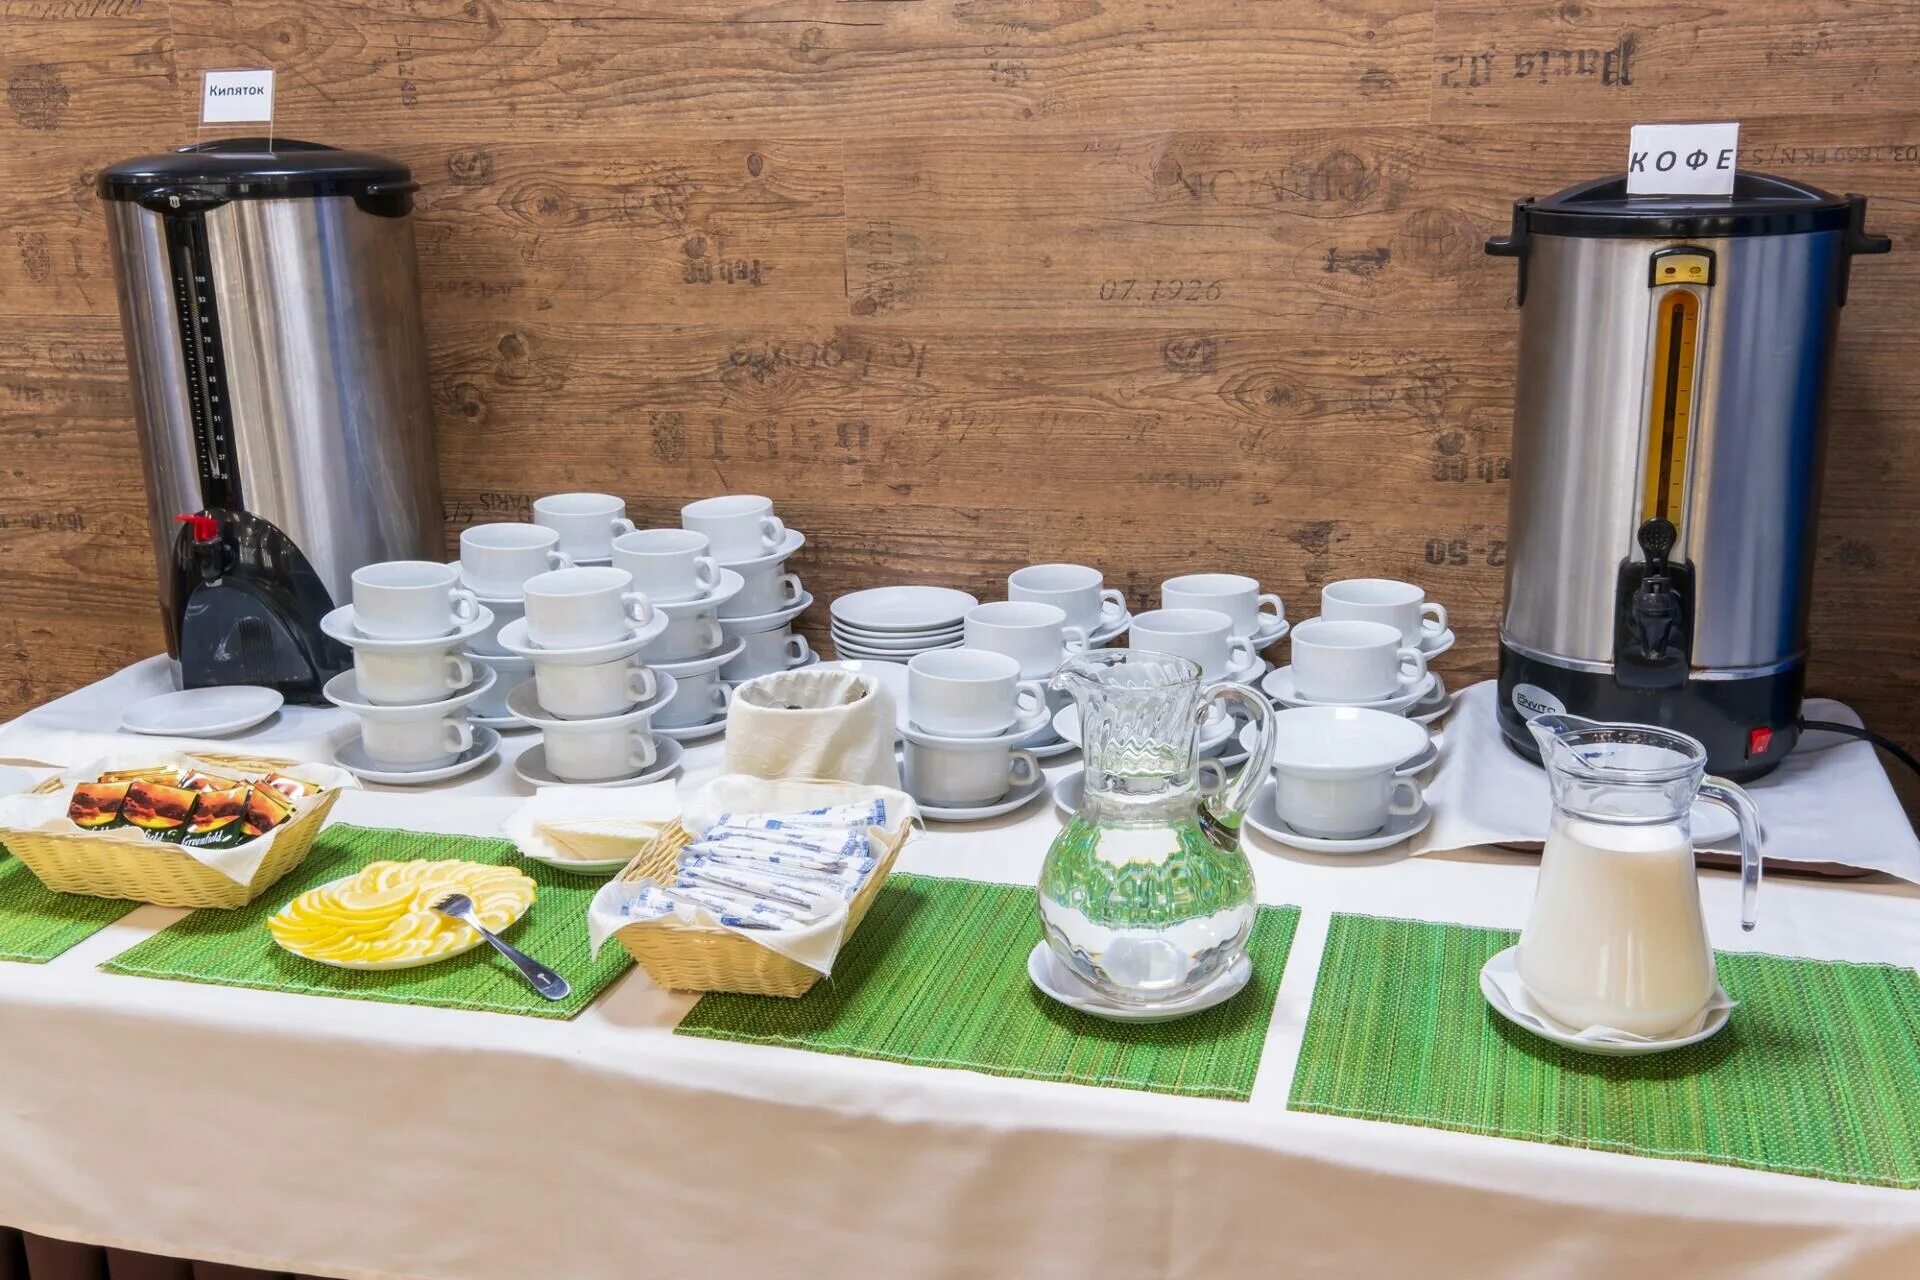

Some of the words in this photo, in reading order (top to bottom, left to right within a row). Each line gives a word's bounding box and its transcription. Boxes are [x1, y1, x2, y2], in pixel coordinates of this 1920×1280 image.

[209, 84, 264, 97] Кипяток
[1630, 148, 1734, 173] КОФЕ
[1099, 279, 1223, 301] 07.1926
[181, 830, 224, 847] Greenfield
